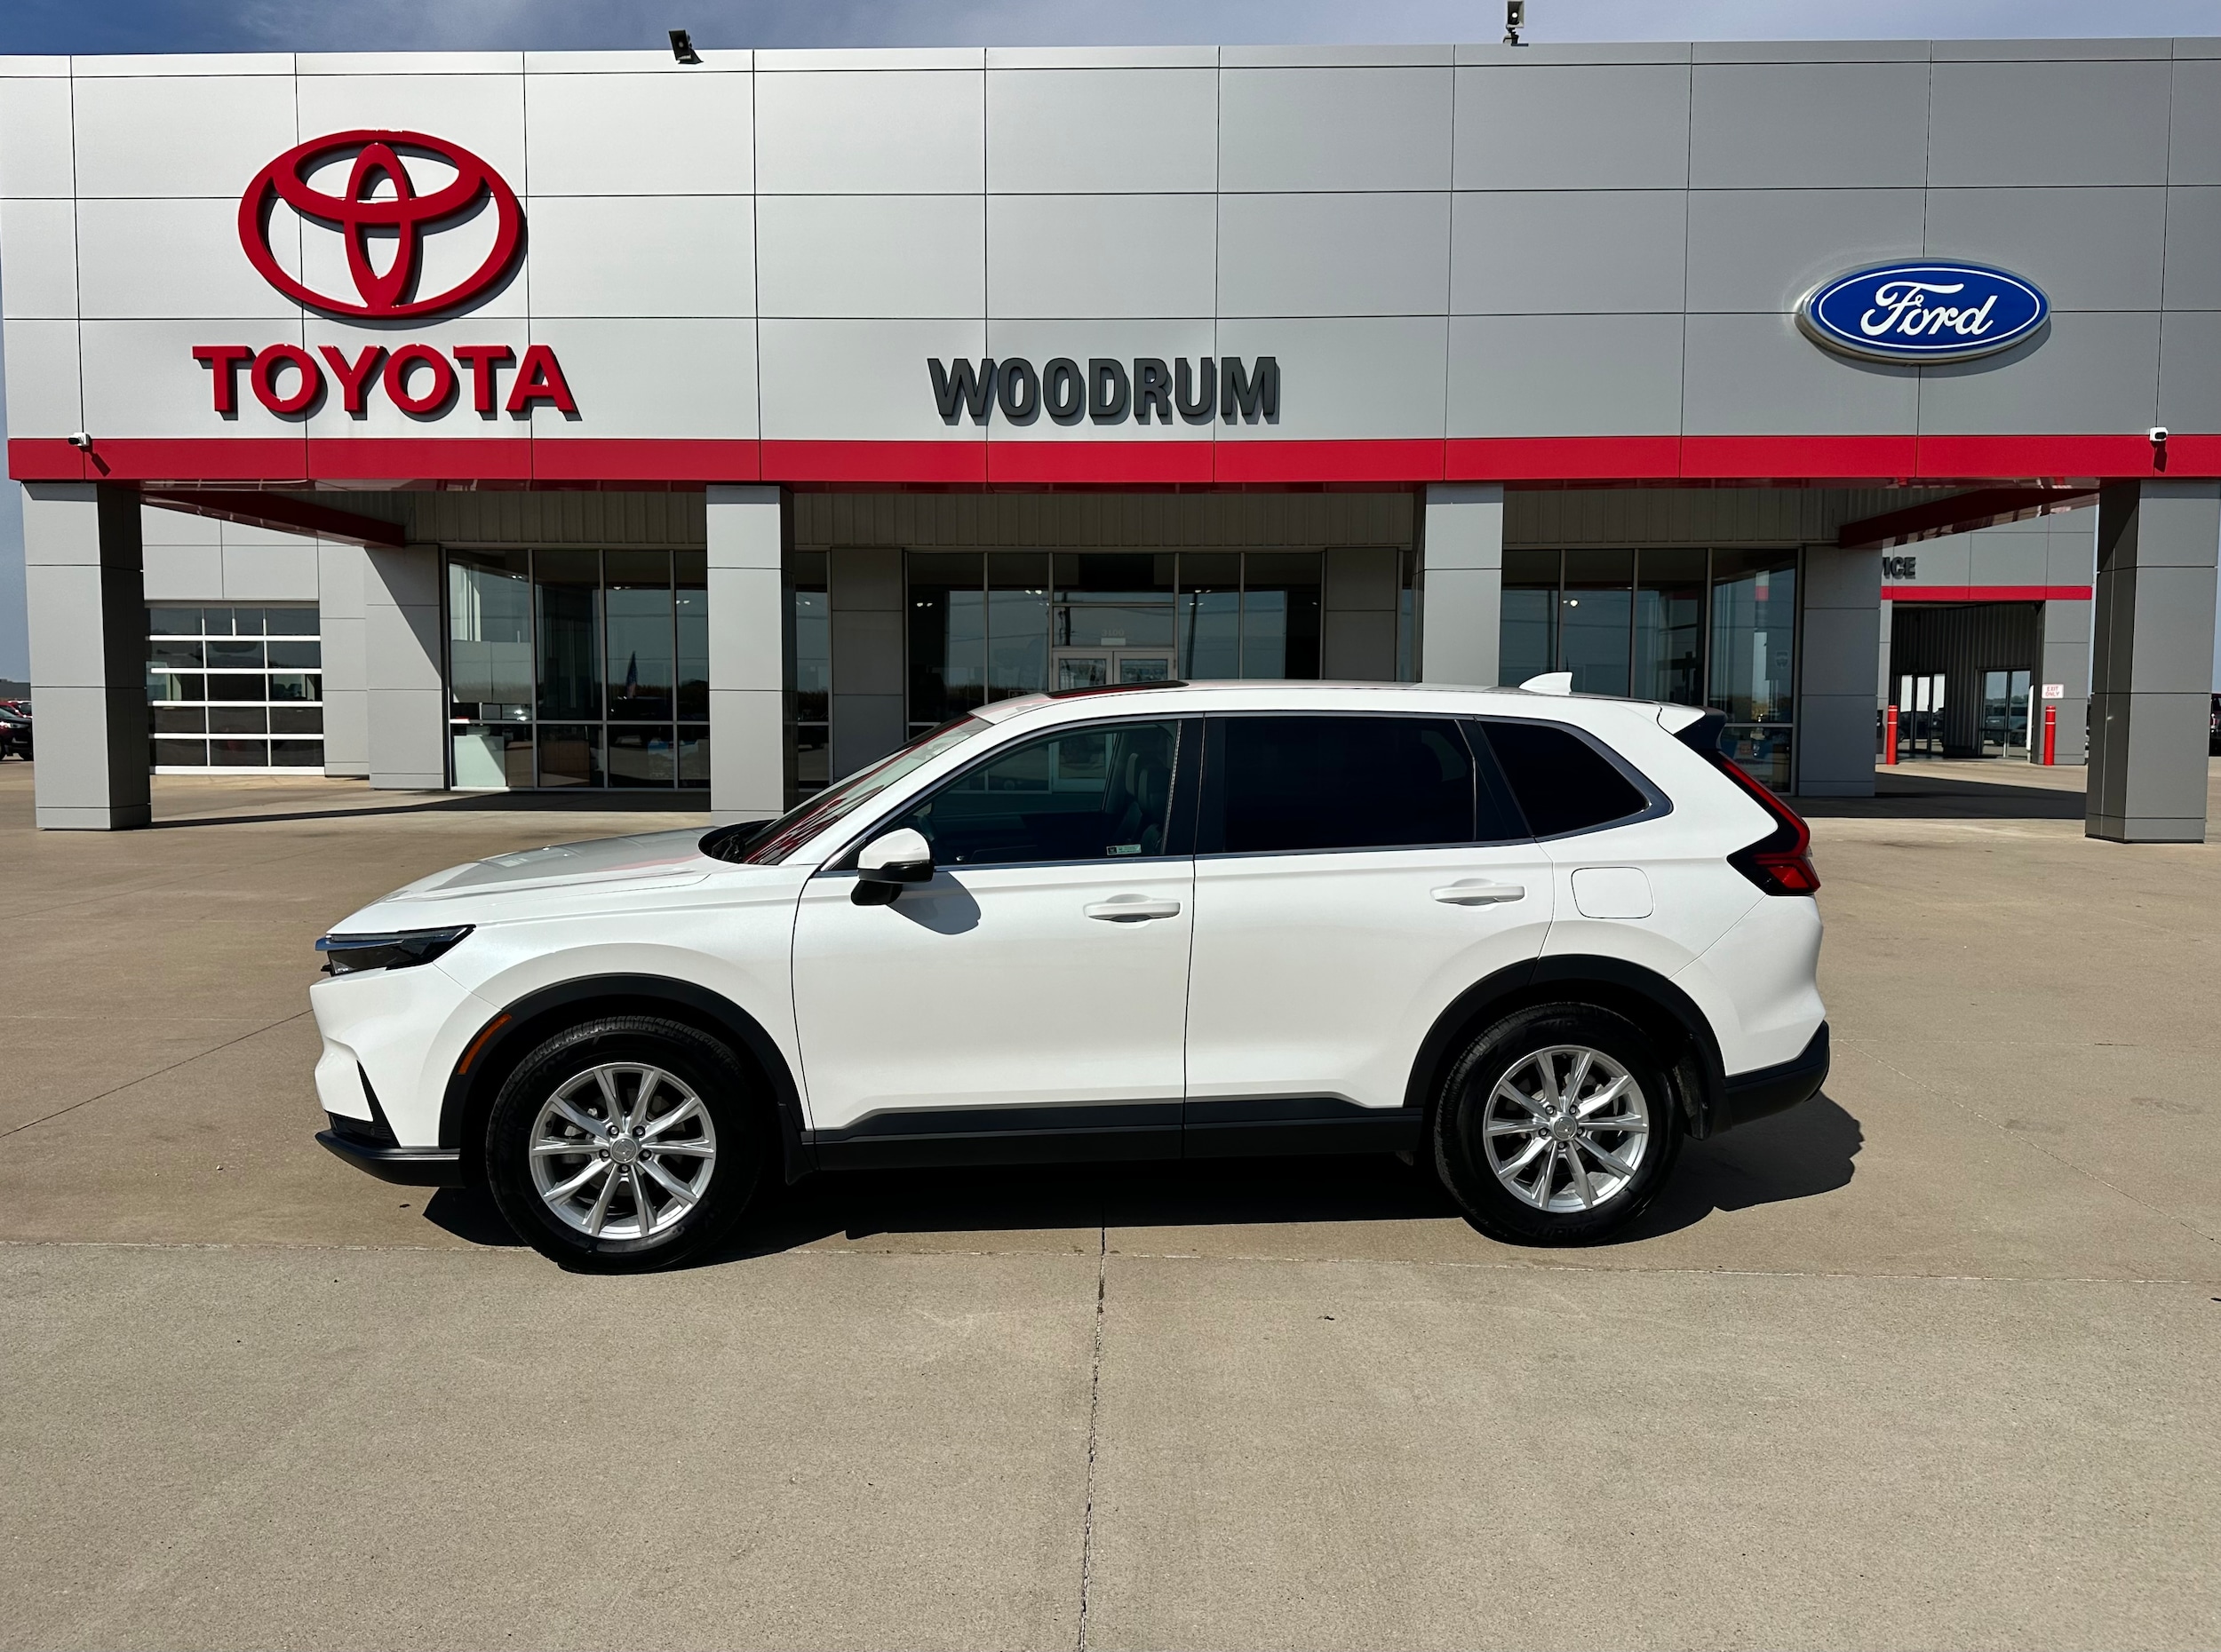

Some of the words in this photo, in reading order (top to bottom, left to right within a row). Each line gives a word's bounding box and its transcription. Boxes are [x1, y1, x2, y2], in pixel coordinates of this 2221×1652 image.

[1860, 281, 1999, 336] Ford
[192, 343, 577, 414] TOYOTA
[927, 356, 1278, 417] WOODRUM
[1883, 556, 1916, 578] ICE
[1101, 628, 1126, 637] 3100
